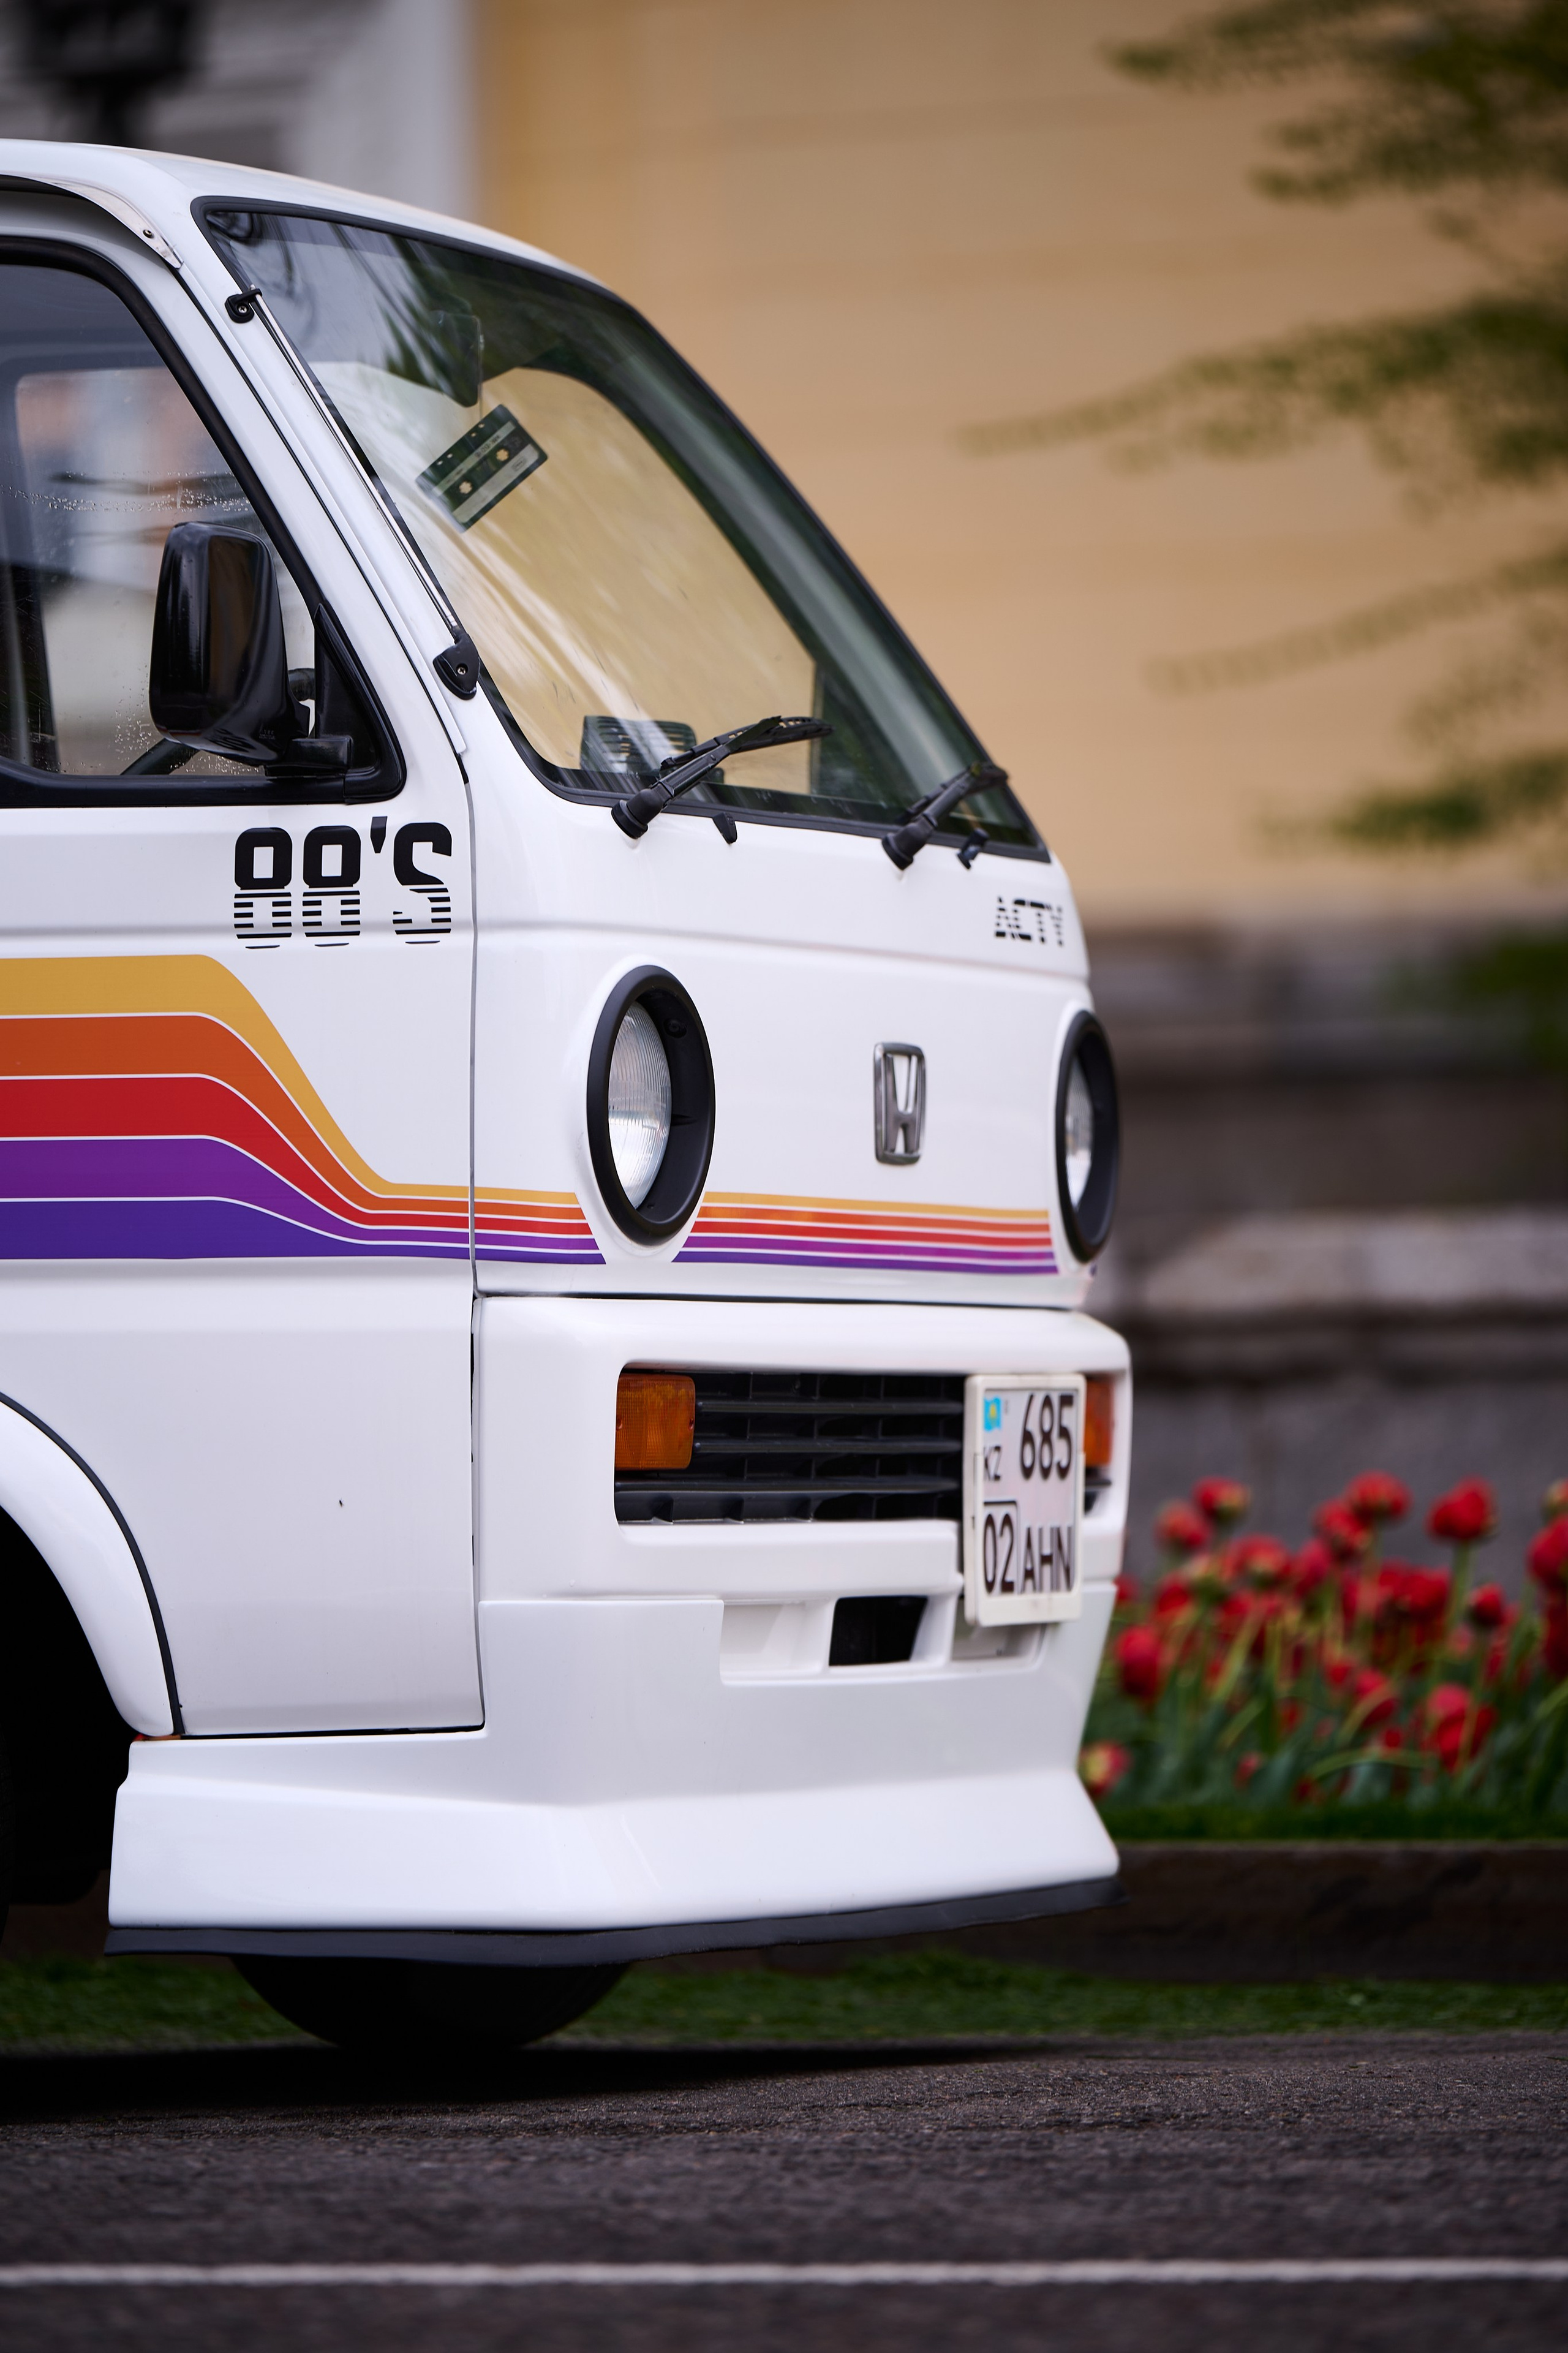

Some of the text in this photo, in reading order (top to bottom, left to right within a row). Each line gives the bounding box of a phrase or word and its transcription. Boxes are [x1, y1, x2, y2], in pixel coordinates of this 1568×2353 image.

[234, 815, 453, 949] 88'S
[995, 896, 1063, 947] ACTY
[984, 1445, 1002, 1481] KZ
[1019, 1393, 1074, 1481] 685
[983, 1513, 1073, 1593] 02 AHN
